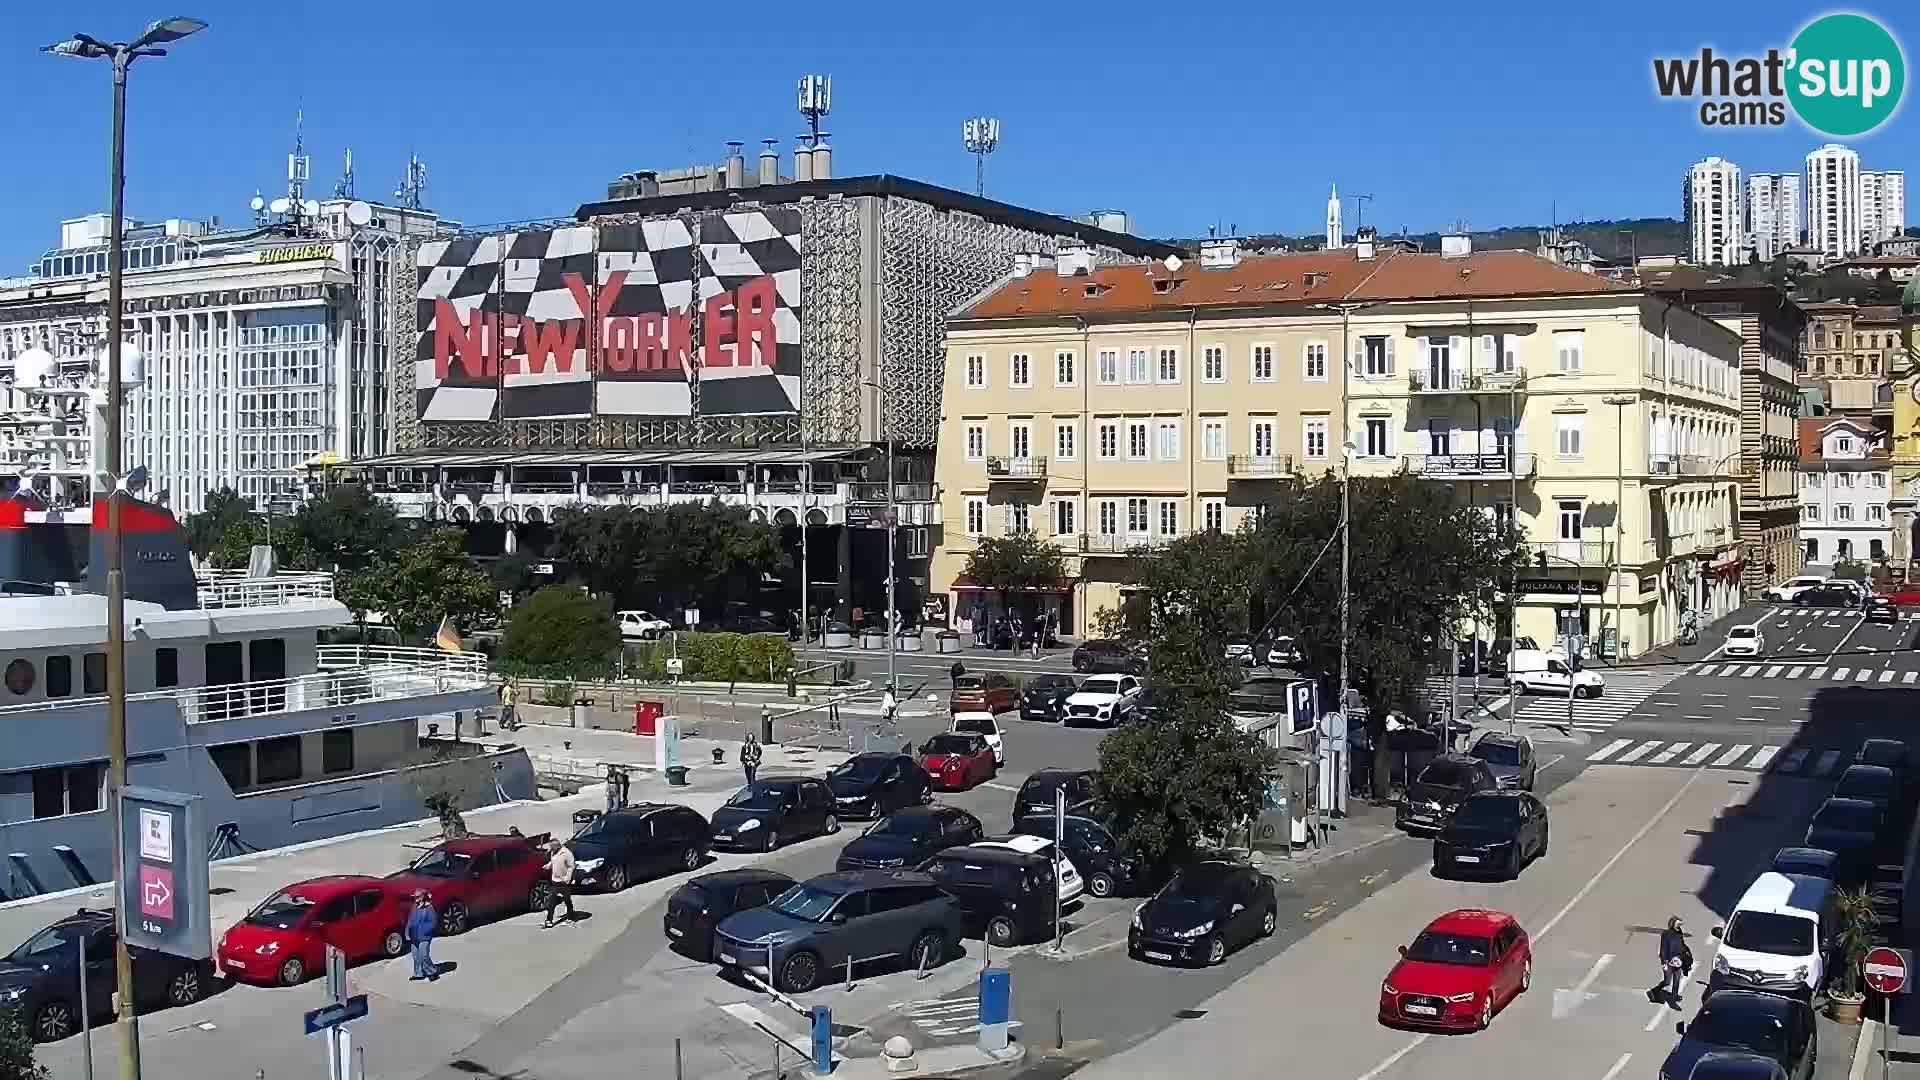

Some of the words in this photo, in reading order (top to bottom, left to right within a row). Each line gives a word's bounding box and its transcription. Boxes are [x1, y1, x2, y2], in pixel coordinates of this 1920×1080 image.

[434, 295, 581, 379] NEW
[560, 270, 777, 373] YORKER
[1297, 687, 1309, 711] P
